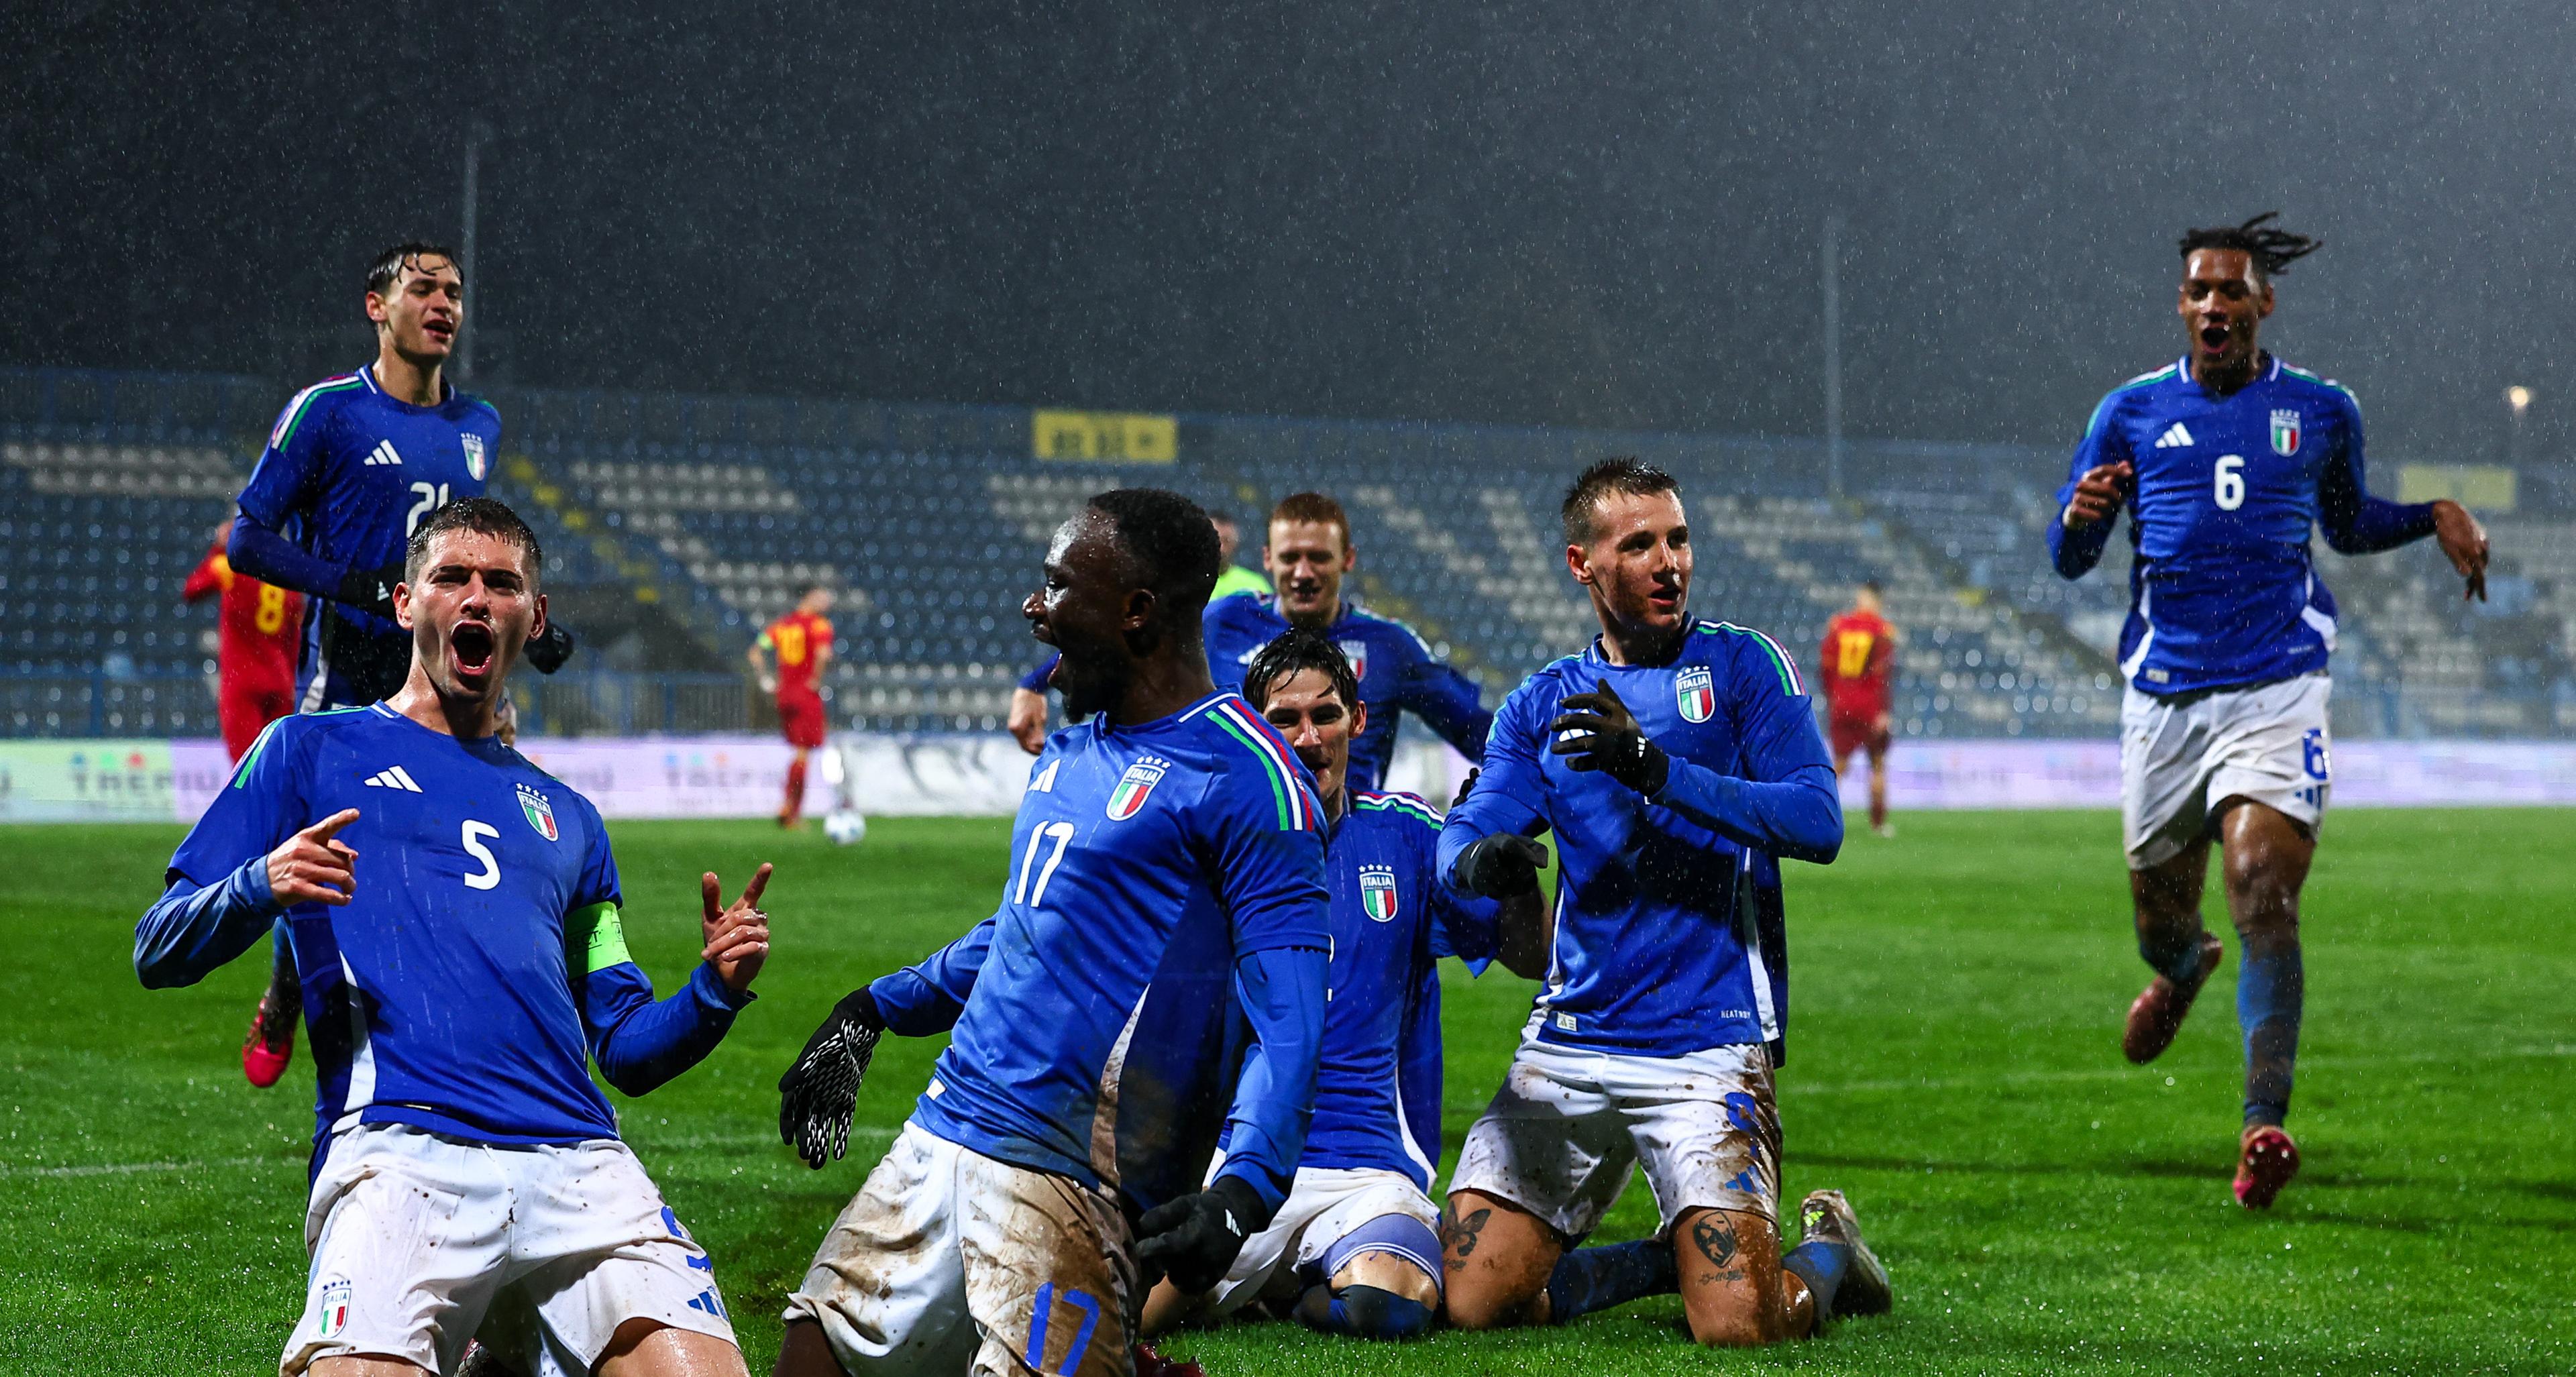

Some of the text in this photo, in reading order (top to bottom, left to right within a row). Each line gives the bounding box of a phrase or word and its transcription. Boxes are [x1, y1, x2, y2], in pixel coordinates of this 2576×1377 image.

[2214, 454, 2245, 510] 6
[256, 584, 286, 635] 8
[1679, 675, 1708, 690] ITALIA
[1127, 768, 1159, 783] ITALIA
[2303, 728, 2328, 781] 6
[521, 795, 550, 813] ITALIA
[462, 819, 501, 891] 5
[1014, 820, 1075, 907] 17
[1362, 876, 1392, 886] ITALIA
[324, 1292, 347, 1305] ITALIA
[1025, 1281, 1100, 1377] 17
